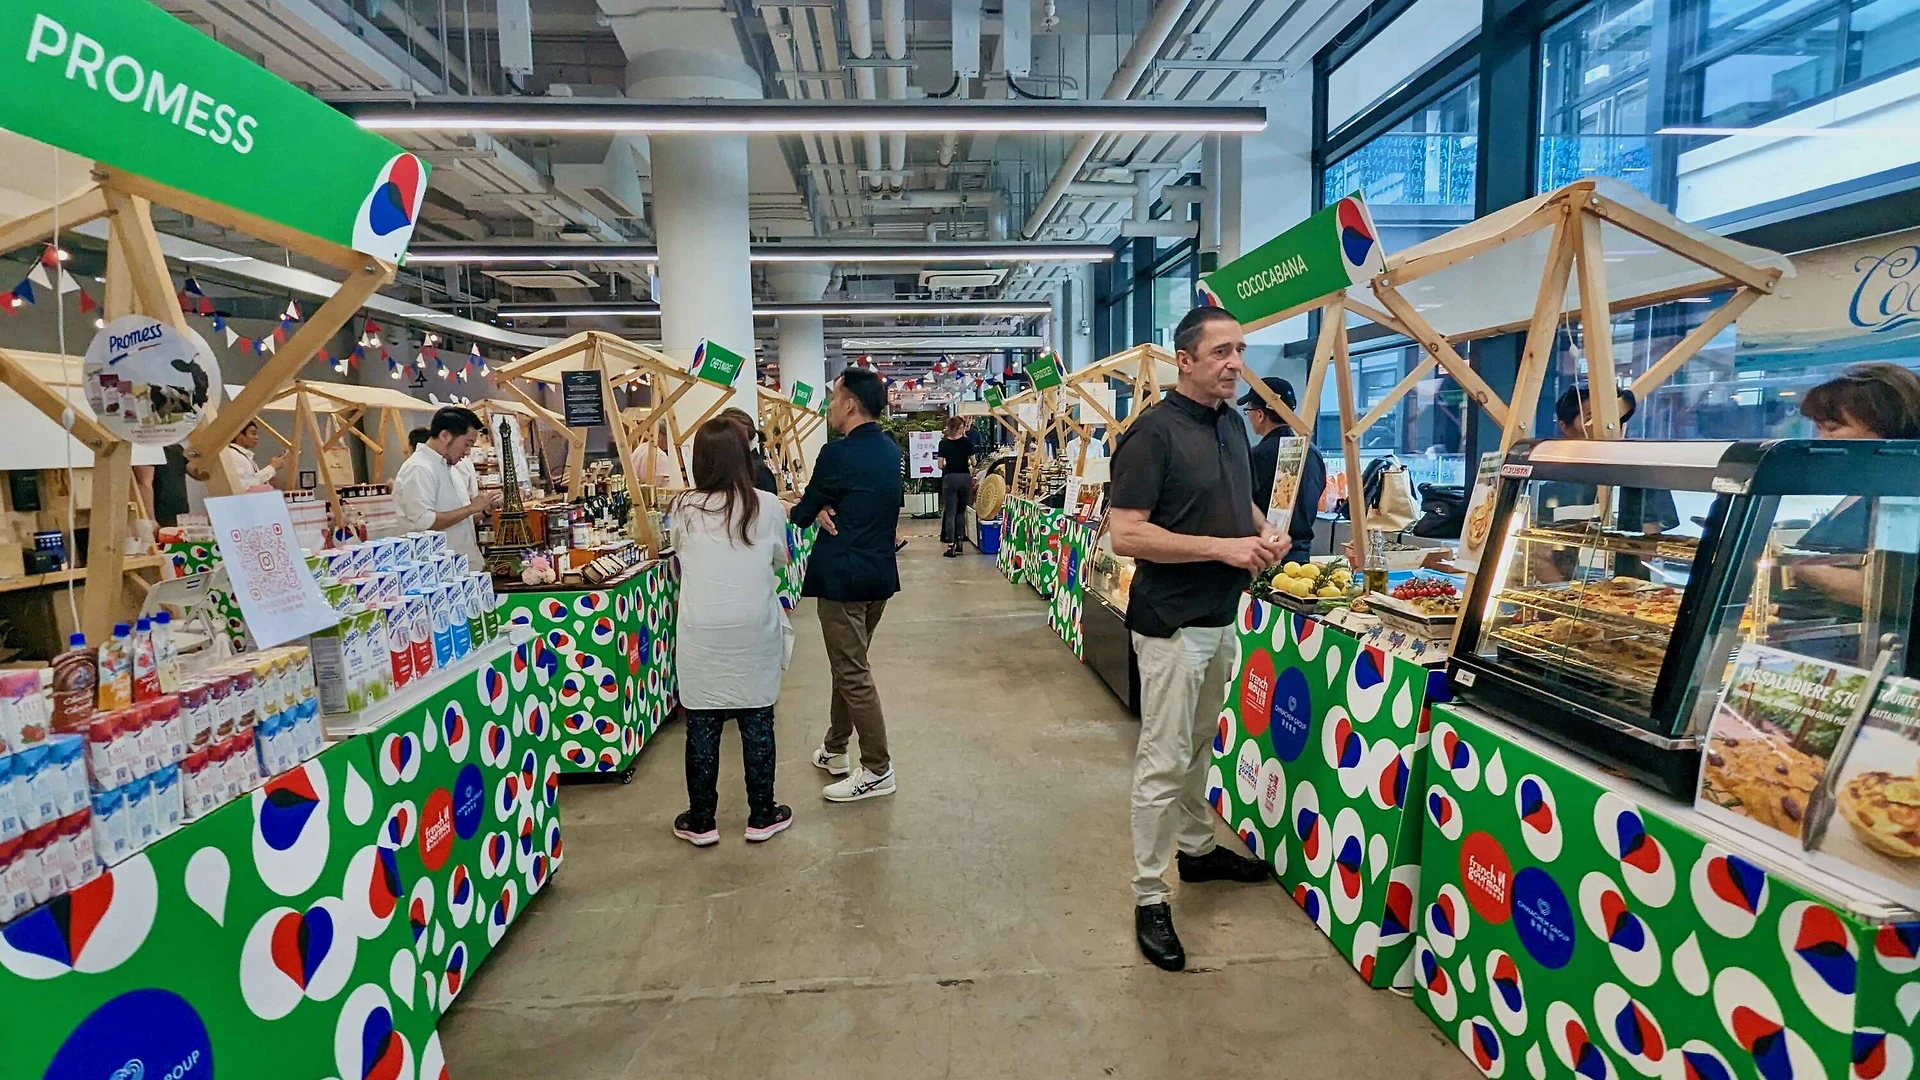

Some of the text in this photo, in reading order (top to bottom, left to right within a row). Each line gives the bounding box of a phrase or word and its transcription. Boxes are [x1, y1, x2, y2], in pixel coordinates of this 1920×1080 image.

[25, 13, 258, 154] PROMESS
[1236, 254, 1309, 300] COCOCABANA
[109, 324, 162, 353] Promess
[1249, 667, 1268, 691] french
[1741, 667, 1832, 701] PISSALADIERE
[1469, 855, 1496, 884] french
